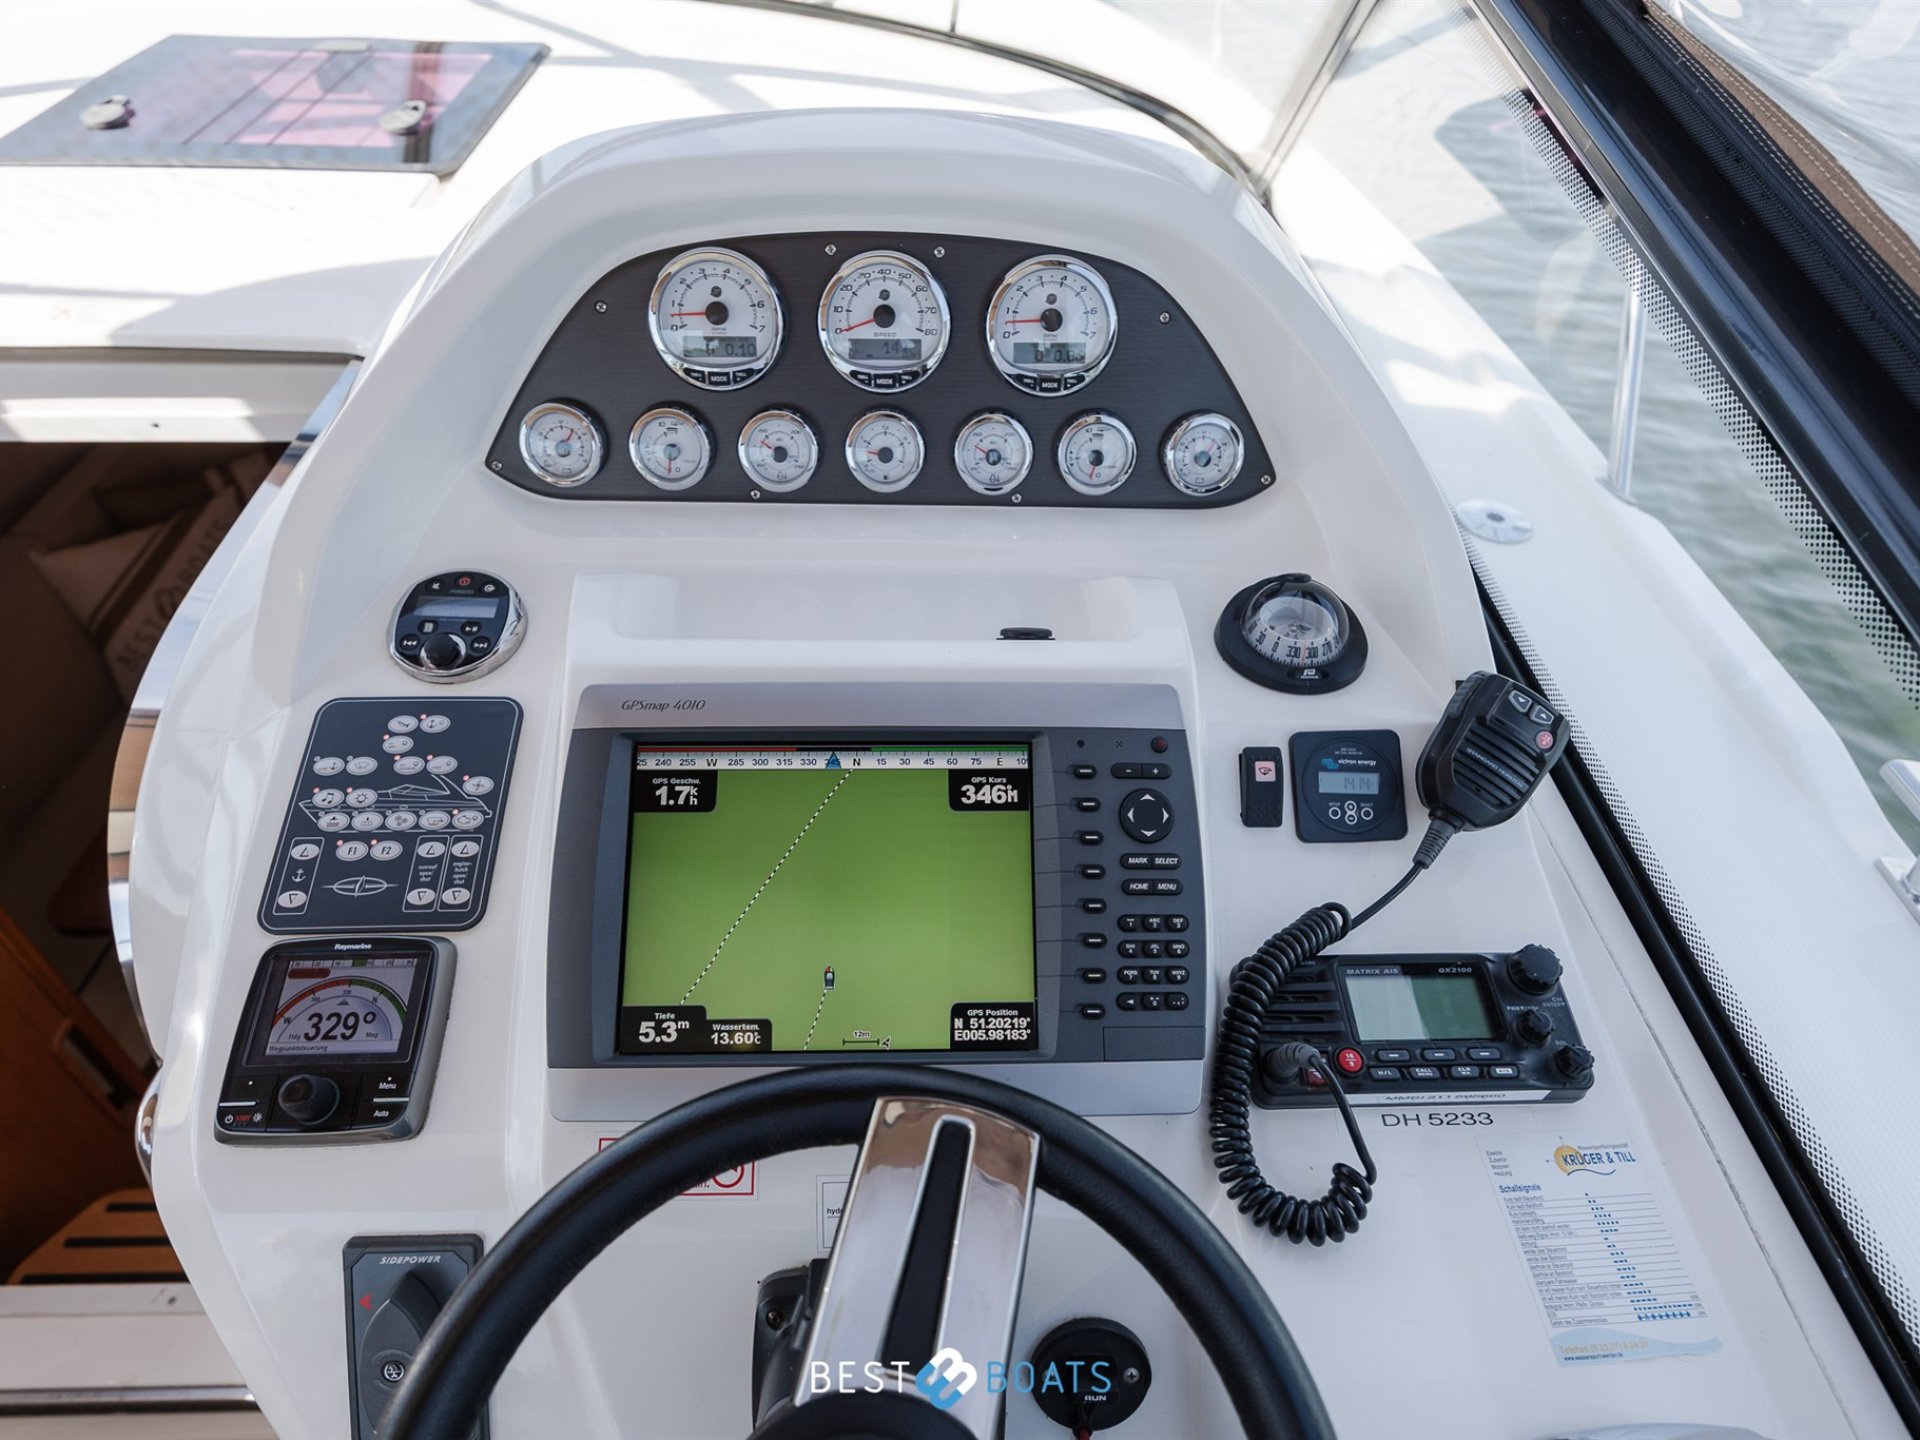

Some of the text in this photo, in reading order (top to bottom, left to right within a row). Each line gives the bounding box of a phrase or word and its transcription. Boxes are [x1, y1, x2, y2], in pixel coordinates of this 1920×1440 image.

[840, 284, 853, 292] 20
[756, 300, 765, 308] 6
[670, 324, 679, 332] 0
[758, 325, 766, 333] 7
[924, 328, 938, 336] 80
[1003, 331, 1011, 339] 0
[1286, 645, 1301, 659] 330
[1306, 646, 1319, 659] 300
[621, 699, 706, 712] GPSmap 4010
[655, 758, 672, 767] 240
[679, 758, 696, 767] 255
[706, 758, 718, 767] W
[727, 758, 745, 767] 285
[752, 758, 769, 767] 300
[776, 758, 793, 767] 315
[800, 758, 817, 767] 330
[853, 757, 861, 767] N
[876, 758, 887, 766] 15
[899, 758, 911, 766] 30
[923, 758, 935, 766] 45
[947, 758, 958, 766] 60
[971, 758, 982, 766] 75
[997, 757, 1003, 767] E
[347, 846, 358, 855] F1
[380, 846, 392, 855] F2
[1154, 857, 1178, 865] SELECT
[334, 943, 372, 951] Raymarine
[283, 1016, 291, 1024] W
[654, 1012, 676, 1020] Tiefe
[712, 1023, 760, 1031] Wassertem.
[954, 1018, 963, 1029] N
[378, 1082, 397, 1090] Menu
[373, 1109, 390, 1118] Auto
[1381, 1111, 1494, 1127] DH 5233
[1605, 1152, 1615, 1164] &
[1614, 1151, 1636, 1163] TILL
[1499, 1183, 1542, 1194] Schallsignale
[379, 1255, 441, 1265] SIDEPOWER
[1084, 1394, 1107, 1402] RUN
